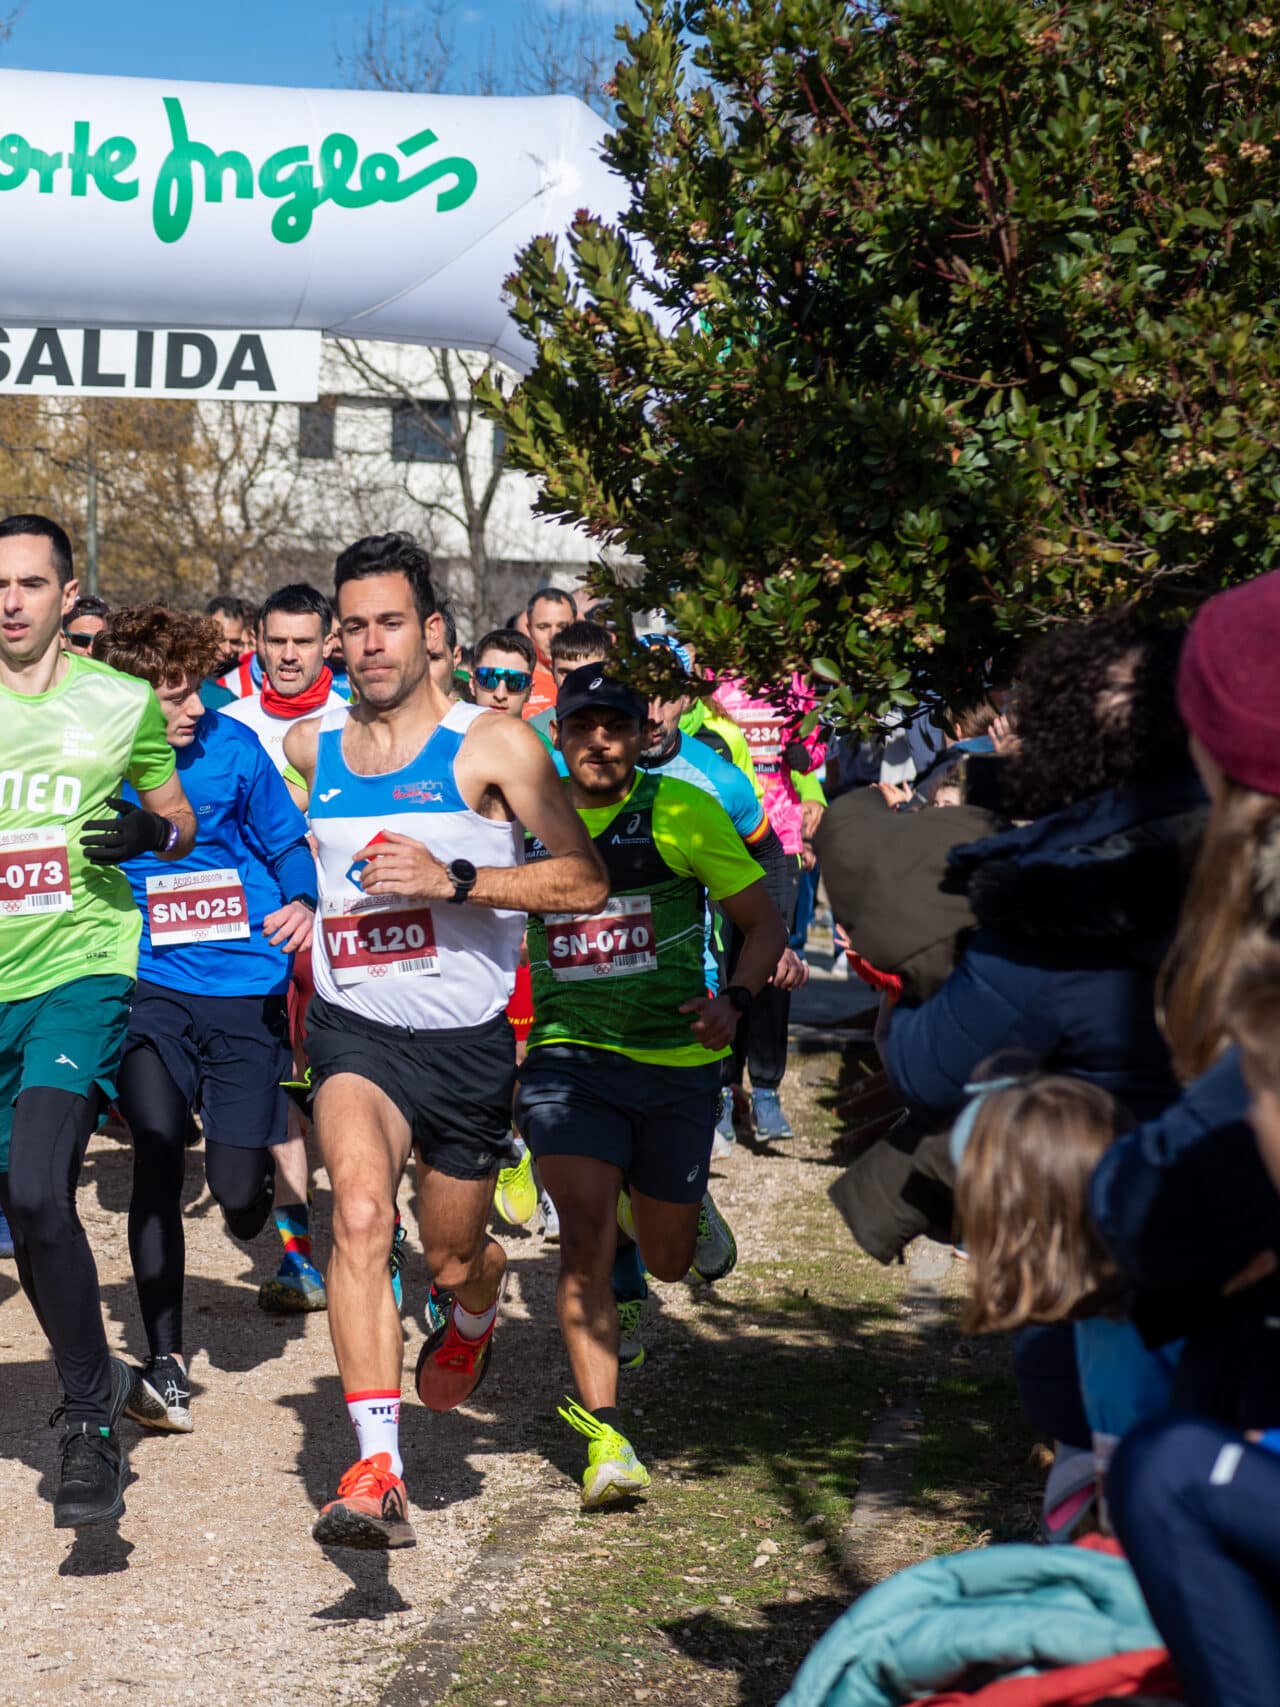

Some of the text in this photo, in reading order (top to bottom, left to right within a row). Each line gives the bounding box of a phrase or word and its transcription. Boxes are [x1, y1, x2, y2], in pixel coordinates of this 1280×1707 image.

[152, 96, 478, 244] Inglés
[152, 896, 242, 924] SN-025
[328, 924, 426, 957] VT-120
[553, 926, 649, 958] SN-070
